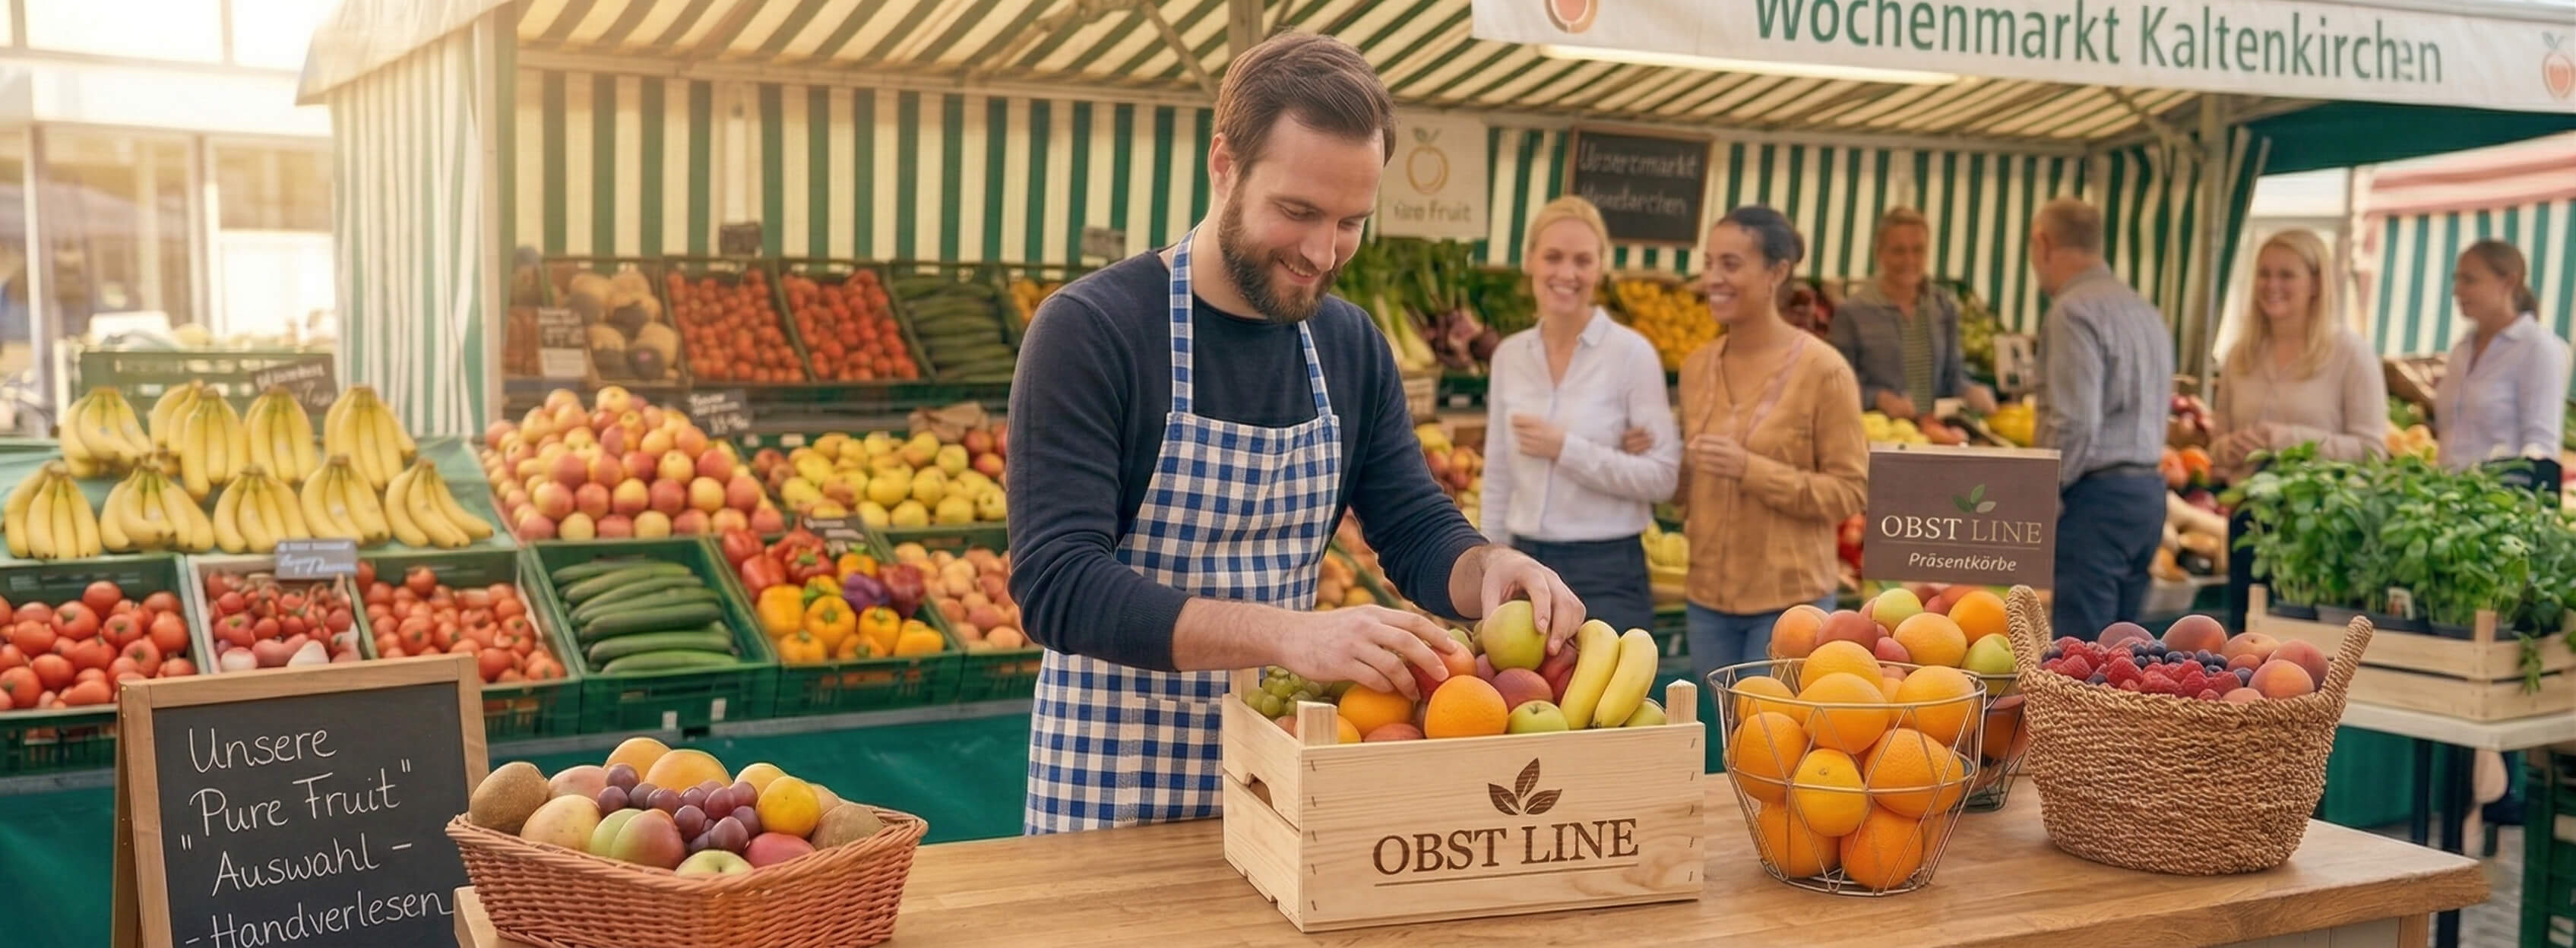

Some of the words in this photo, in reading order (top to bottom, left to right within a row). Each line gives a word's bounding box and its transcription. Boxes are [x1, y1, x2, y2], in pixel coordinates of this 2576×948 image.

[1754, 0, 2120, 64] Wochenmarkt
[2139, 5, 2442, 83] Kaltenkirchen
[1881, 514, 1963, 540] OBST
[1970, 519, 2043, 544] LINE
[1907, 552, 2017, 571] Präsentkörbe
[188, 727, 337, 773] Unsere
[212, 832, 380, 897] Auswahl
[1372, 827, 1507, 874] OBST
[1521, 818, 1639, 864] LINE
[210, 890, 455, 948] Handverlesen
